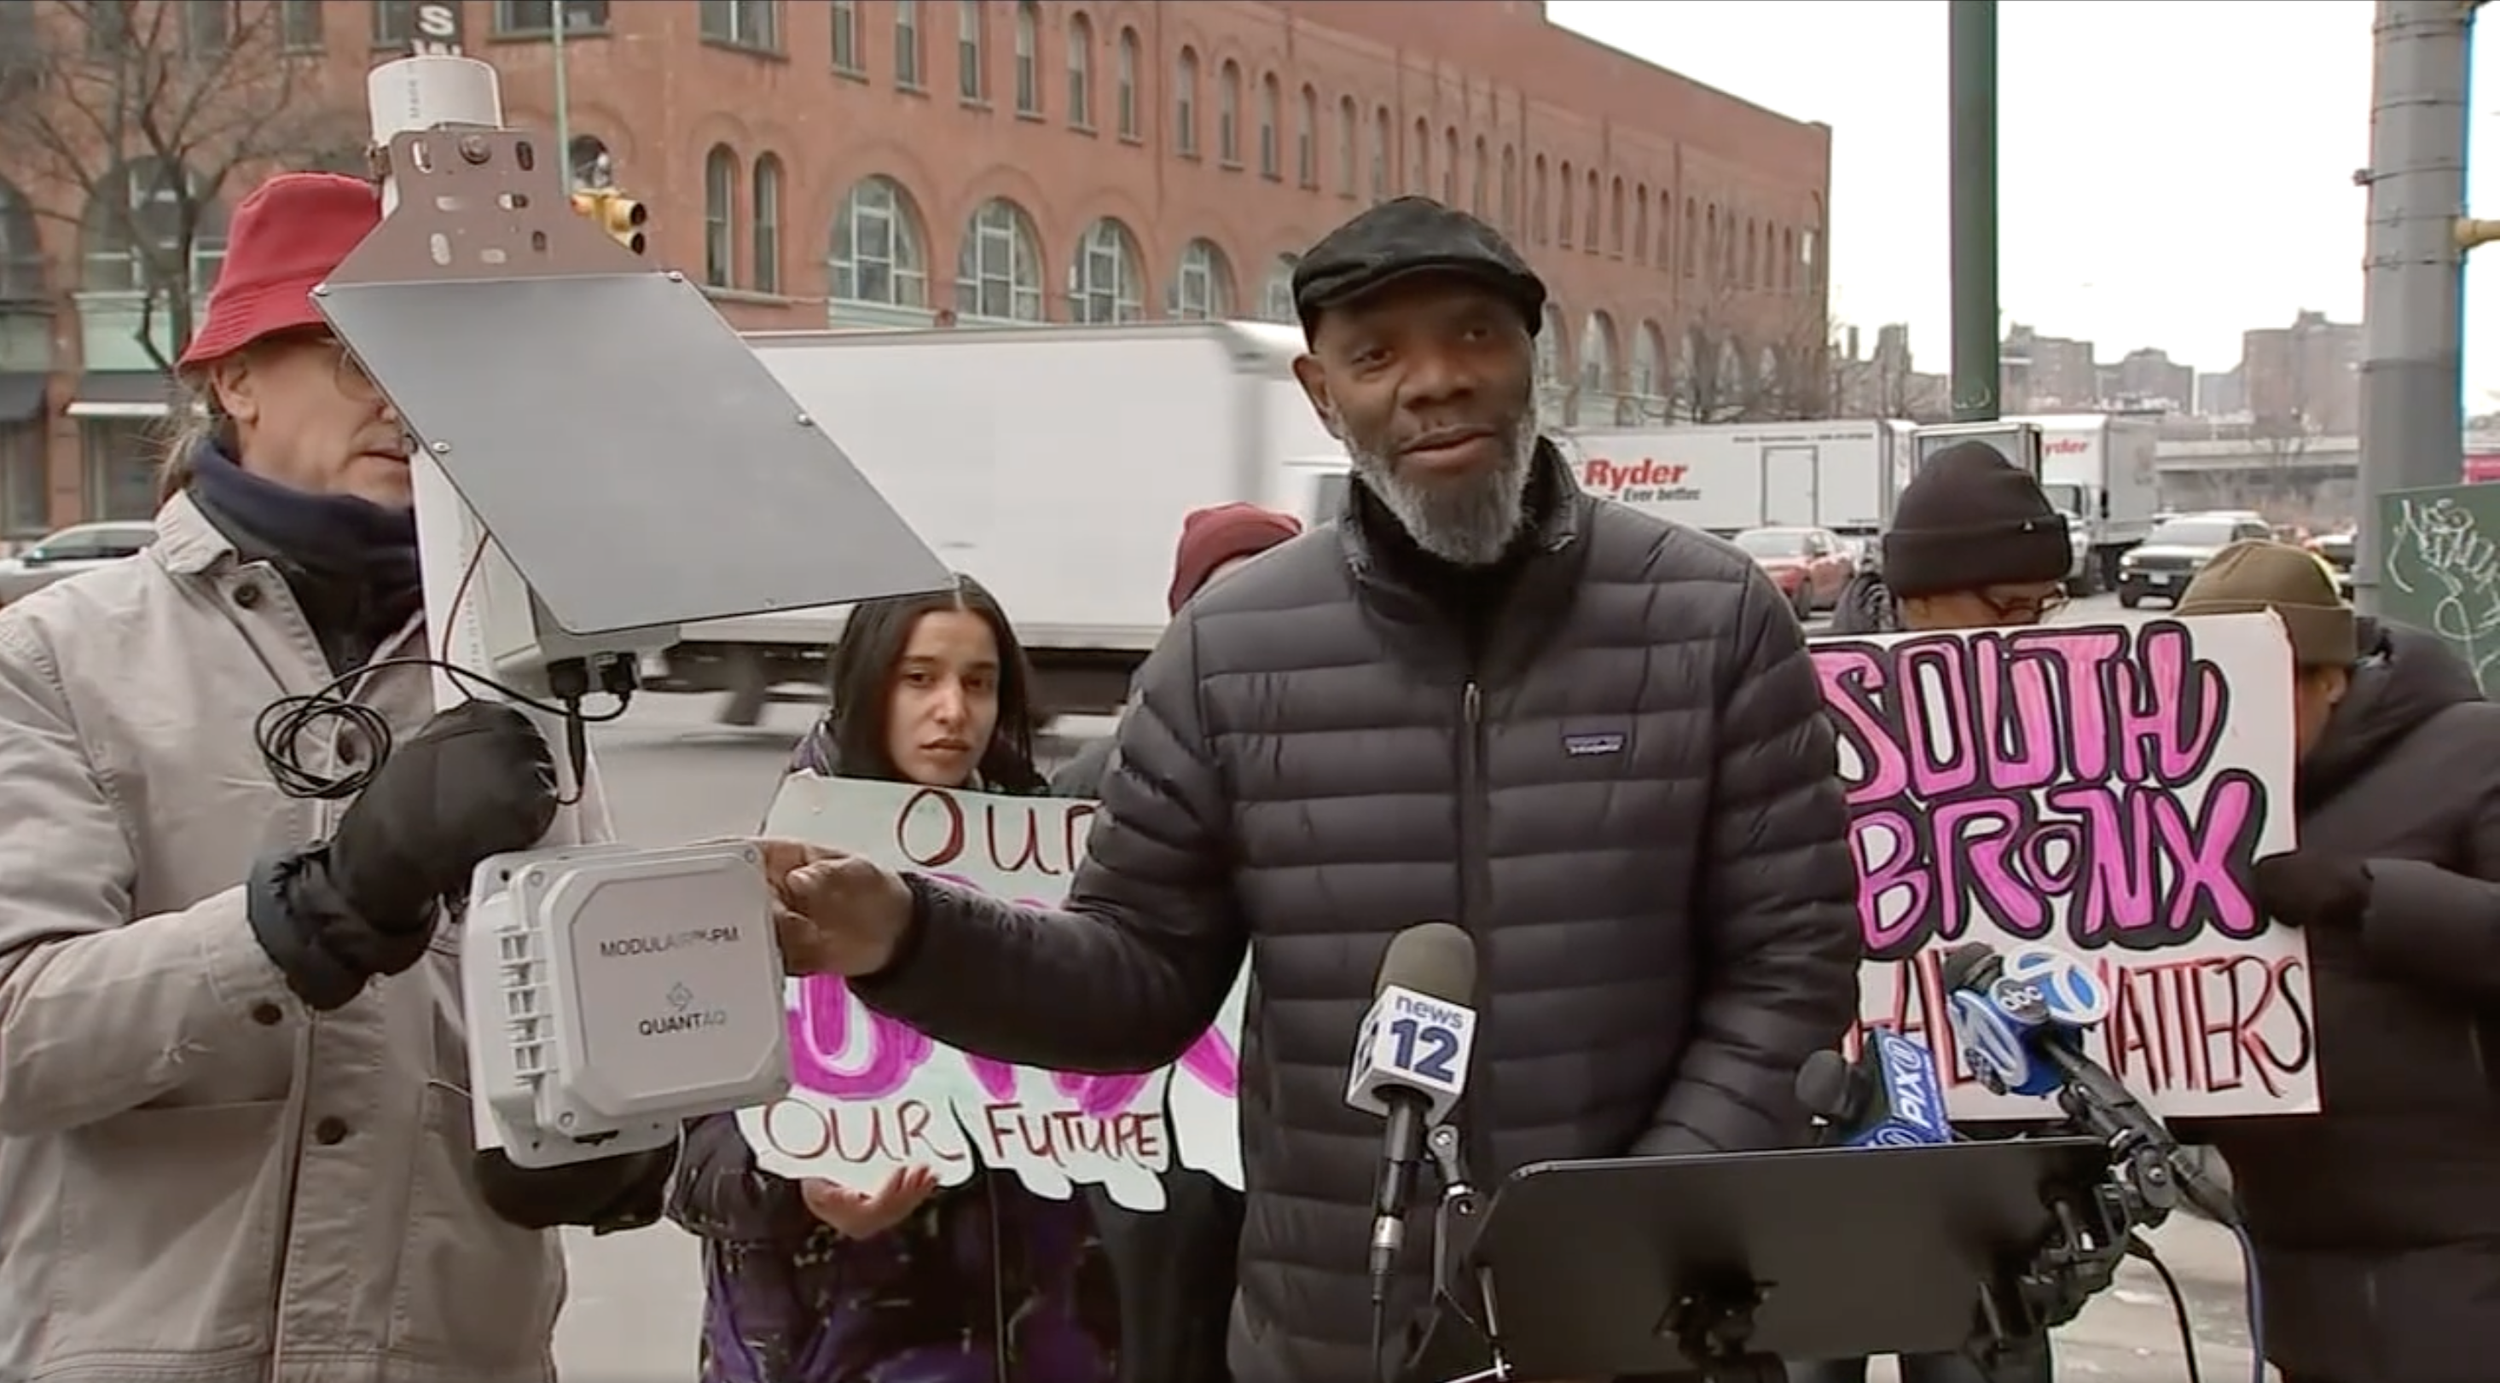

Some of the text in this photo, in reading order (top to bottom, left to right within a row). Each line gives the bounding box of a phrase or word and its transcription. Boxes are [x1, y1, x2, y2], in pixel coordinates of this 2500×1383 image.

[2043, 440, 2089, 457] yder
[1584, 458, 1688, 491] Ryder
[1623, 487, 1653, 502] Ever
[1808, 620, 2230, 806] SOUTH
[1395, 995, 1463, 1030] news
[1391, 1018, 1459, 1084] 12
[764, 1098, 1161, 1170] OUR FUTURE
